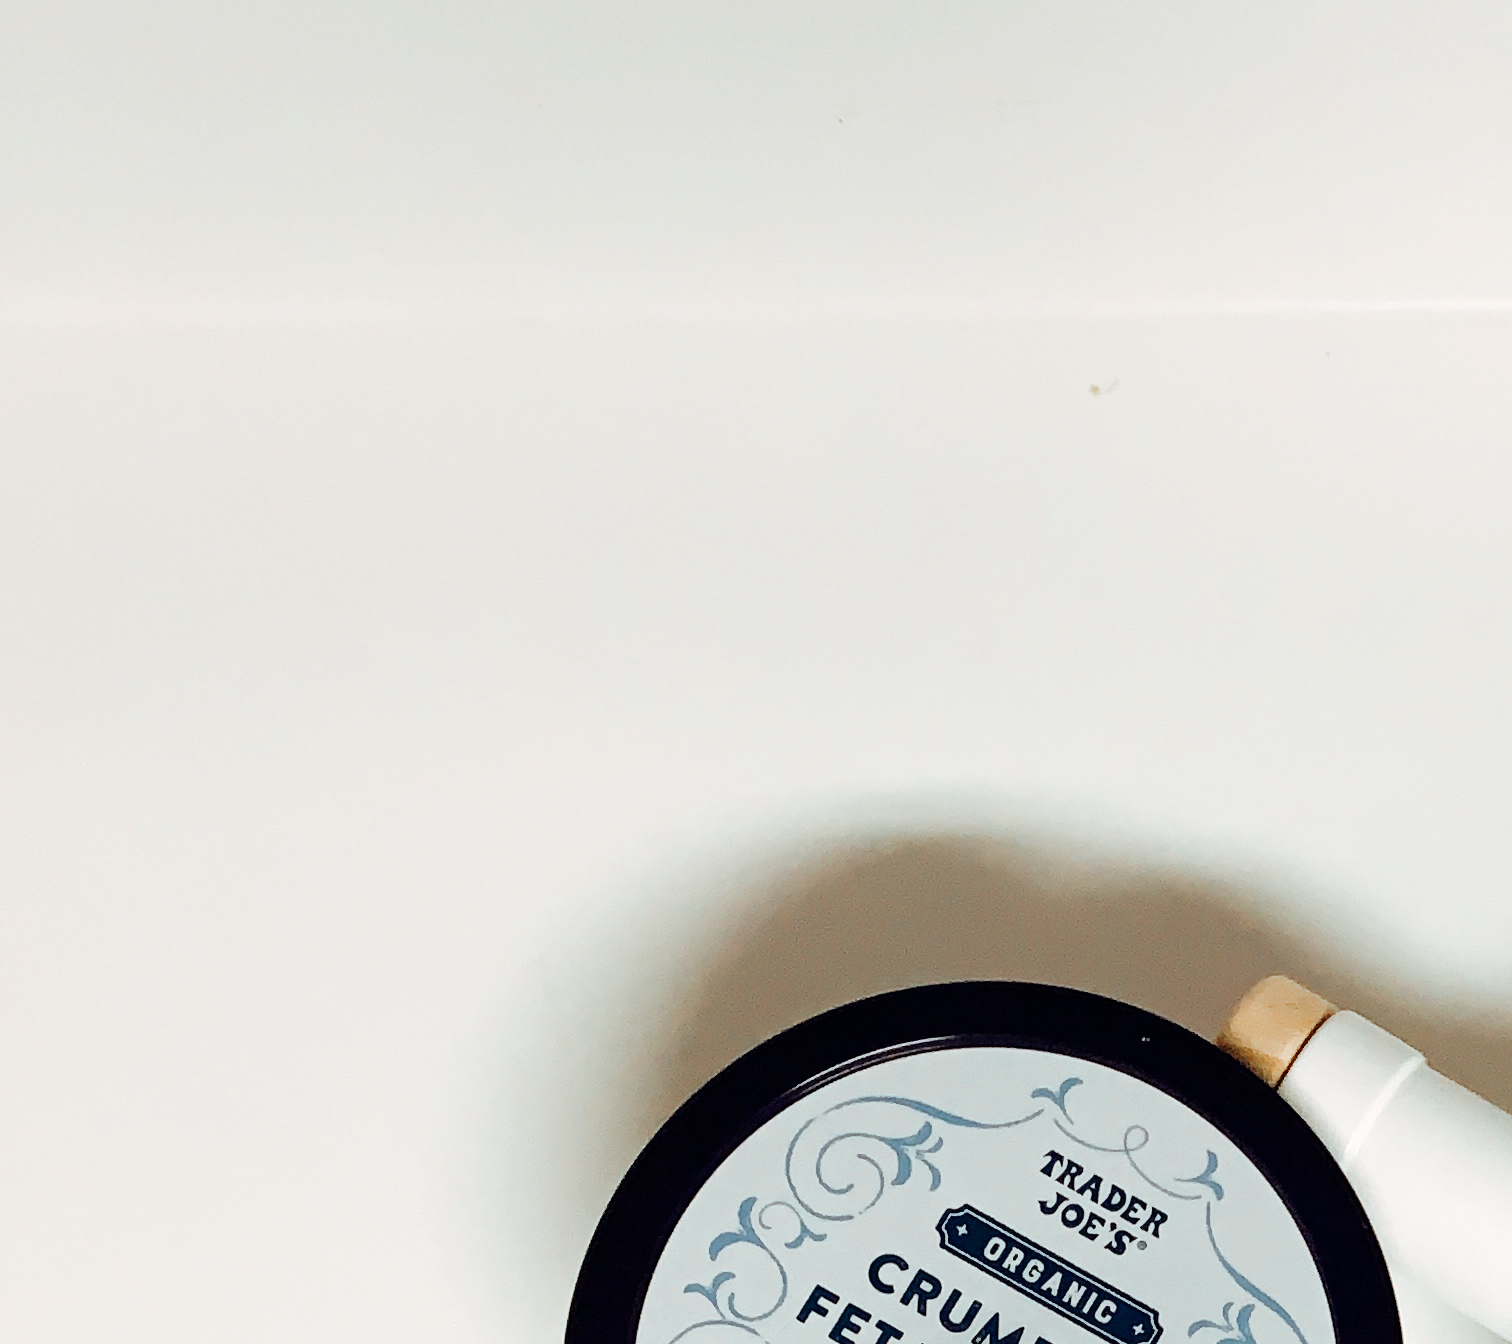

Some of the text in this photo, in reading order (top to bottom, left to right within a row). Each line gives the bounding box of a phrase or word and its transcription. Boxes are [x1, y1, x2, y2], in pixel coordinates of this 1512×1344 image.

[1038, 1192, 1139, 1255] JOE'S
[1040, 1150, 1168, 1238] TRADER
[983, 1236, 1118, 1325] ORGANIC
